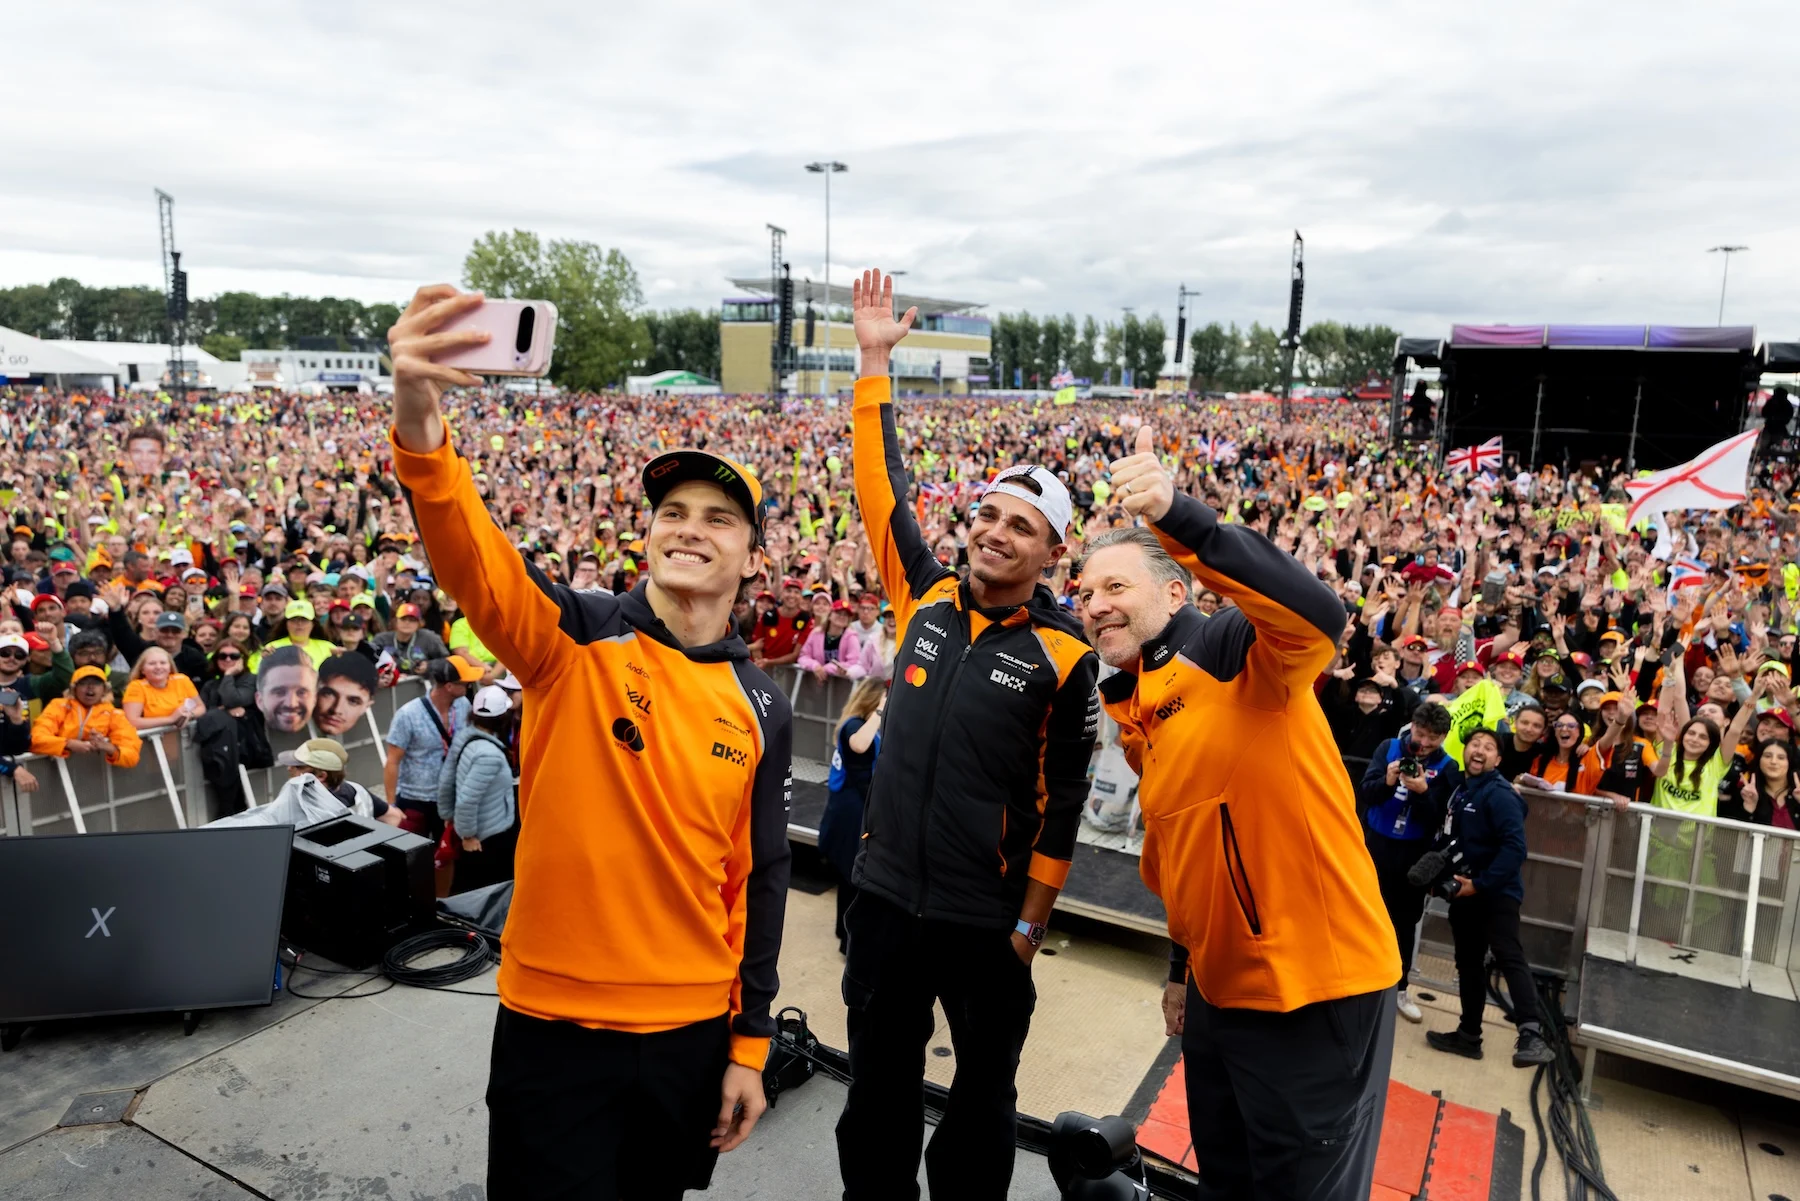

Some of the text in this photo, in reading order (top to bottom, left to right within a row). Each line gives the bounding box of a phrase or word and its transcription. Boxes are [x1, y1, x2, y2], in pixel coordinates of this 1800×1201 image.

[915, 637, 939, 656] DELL
[625, 662, 650, 679] Andro
[996, 652, 1033, 670] McLaren
[990, 669, 1027, 692] OKX
[625, 683, 651, 715] ELL
[1155, 696, 1185, 720] OKX
[711, 741, 748, 767] OKX
[84, 906, 117, 939] X
